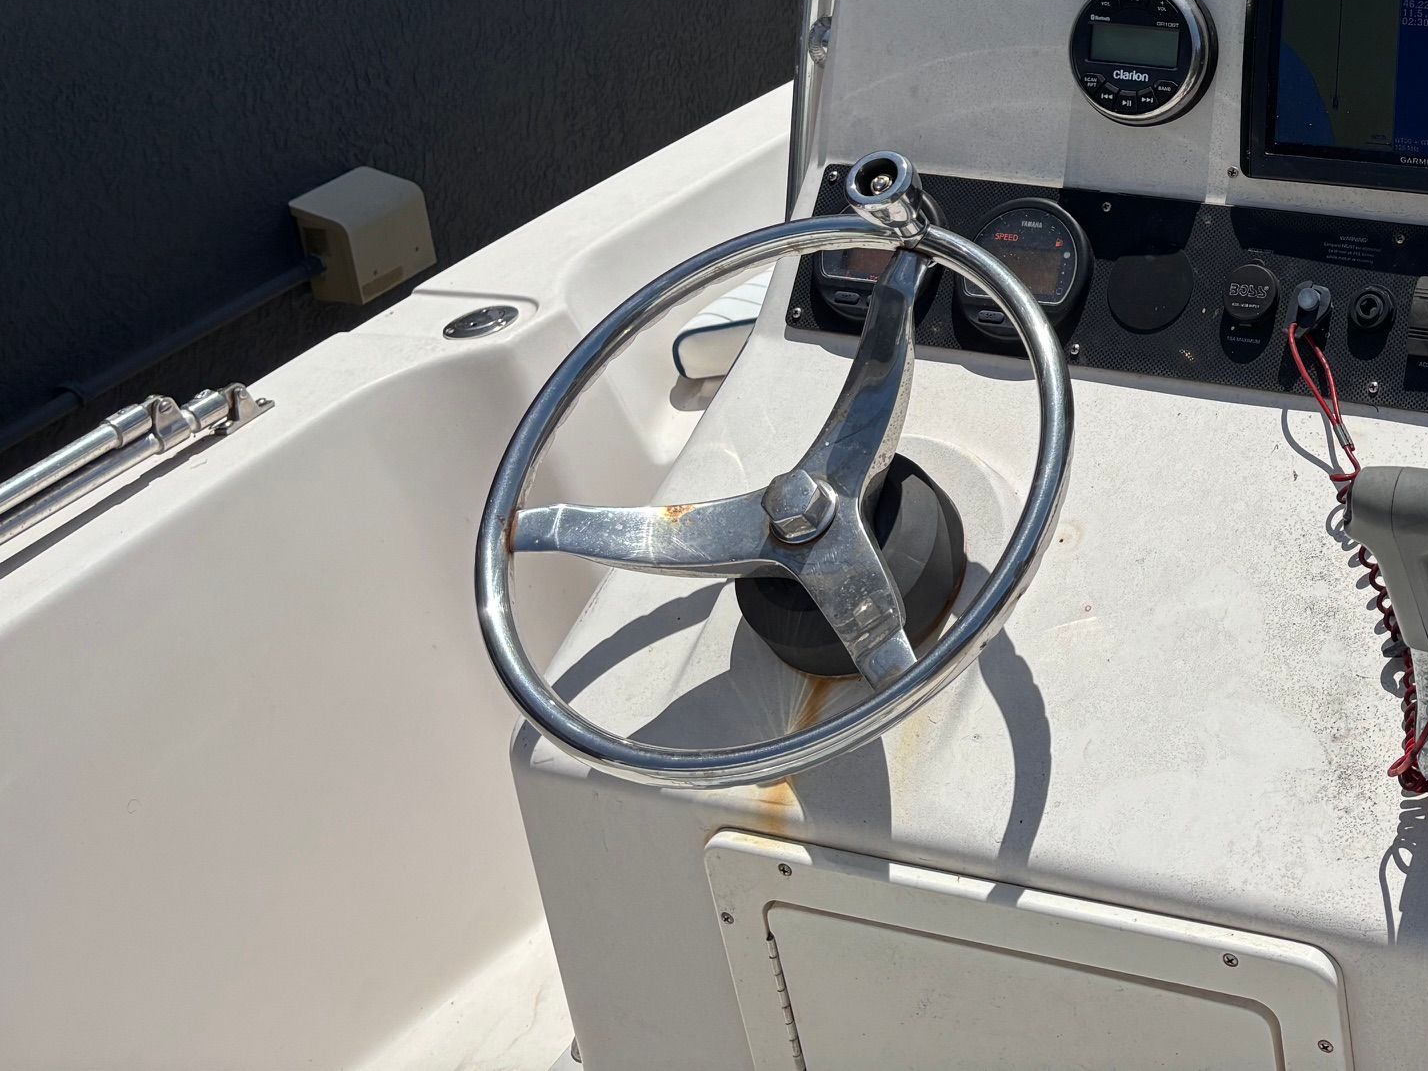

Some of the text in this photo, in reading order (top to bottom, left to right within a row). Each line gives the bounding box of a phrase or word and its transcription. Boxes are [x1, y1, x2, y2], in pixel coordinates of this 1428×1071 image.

[1113, 69, 1149, 82] clarion
[1021, 220, 1043, 229] YAMAHA
[994, 232, 1019, 242] SPEED
